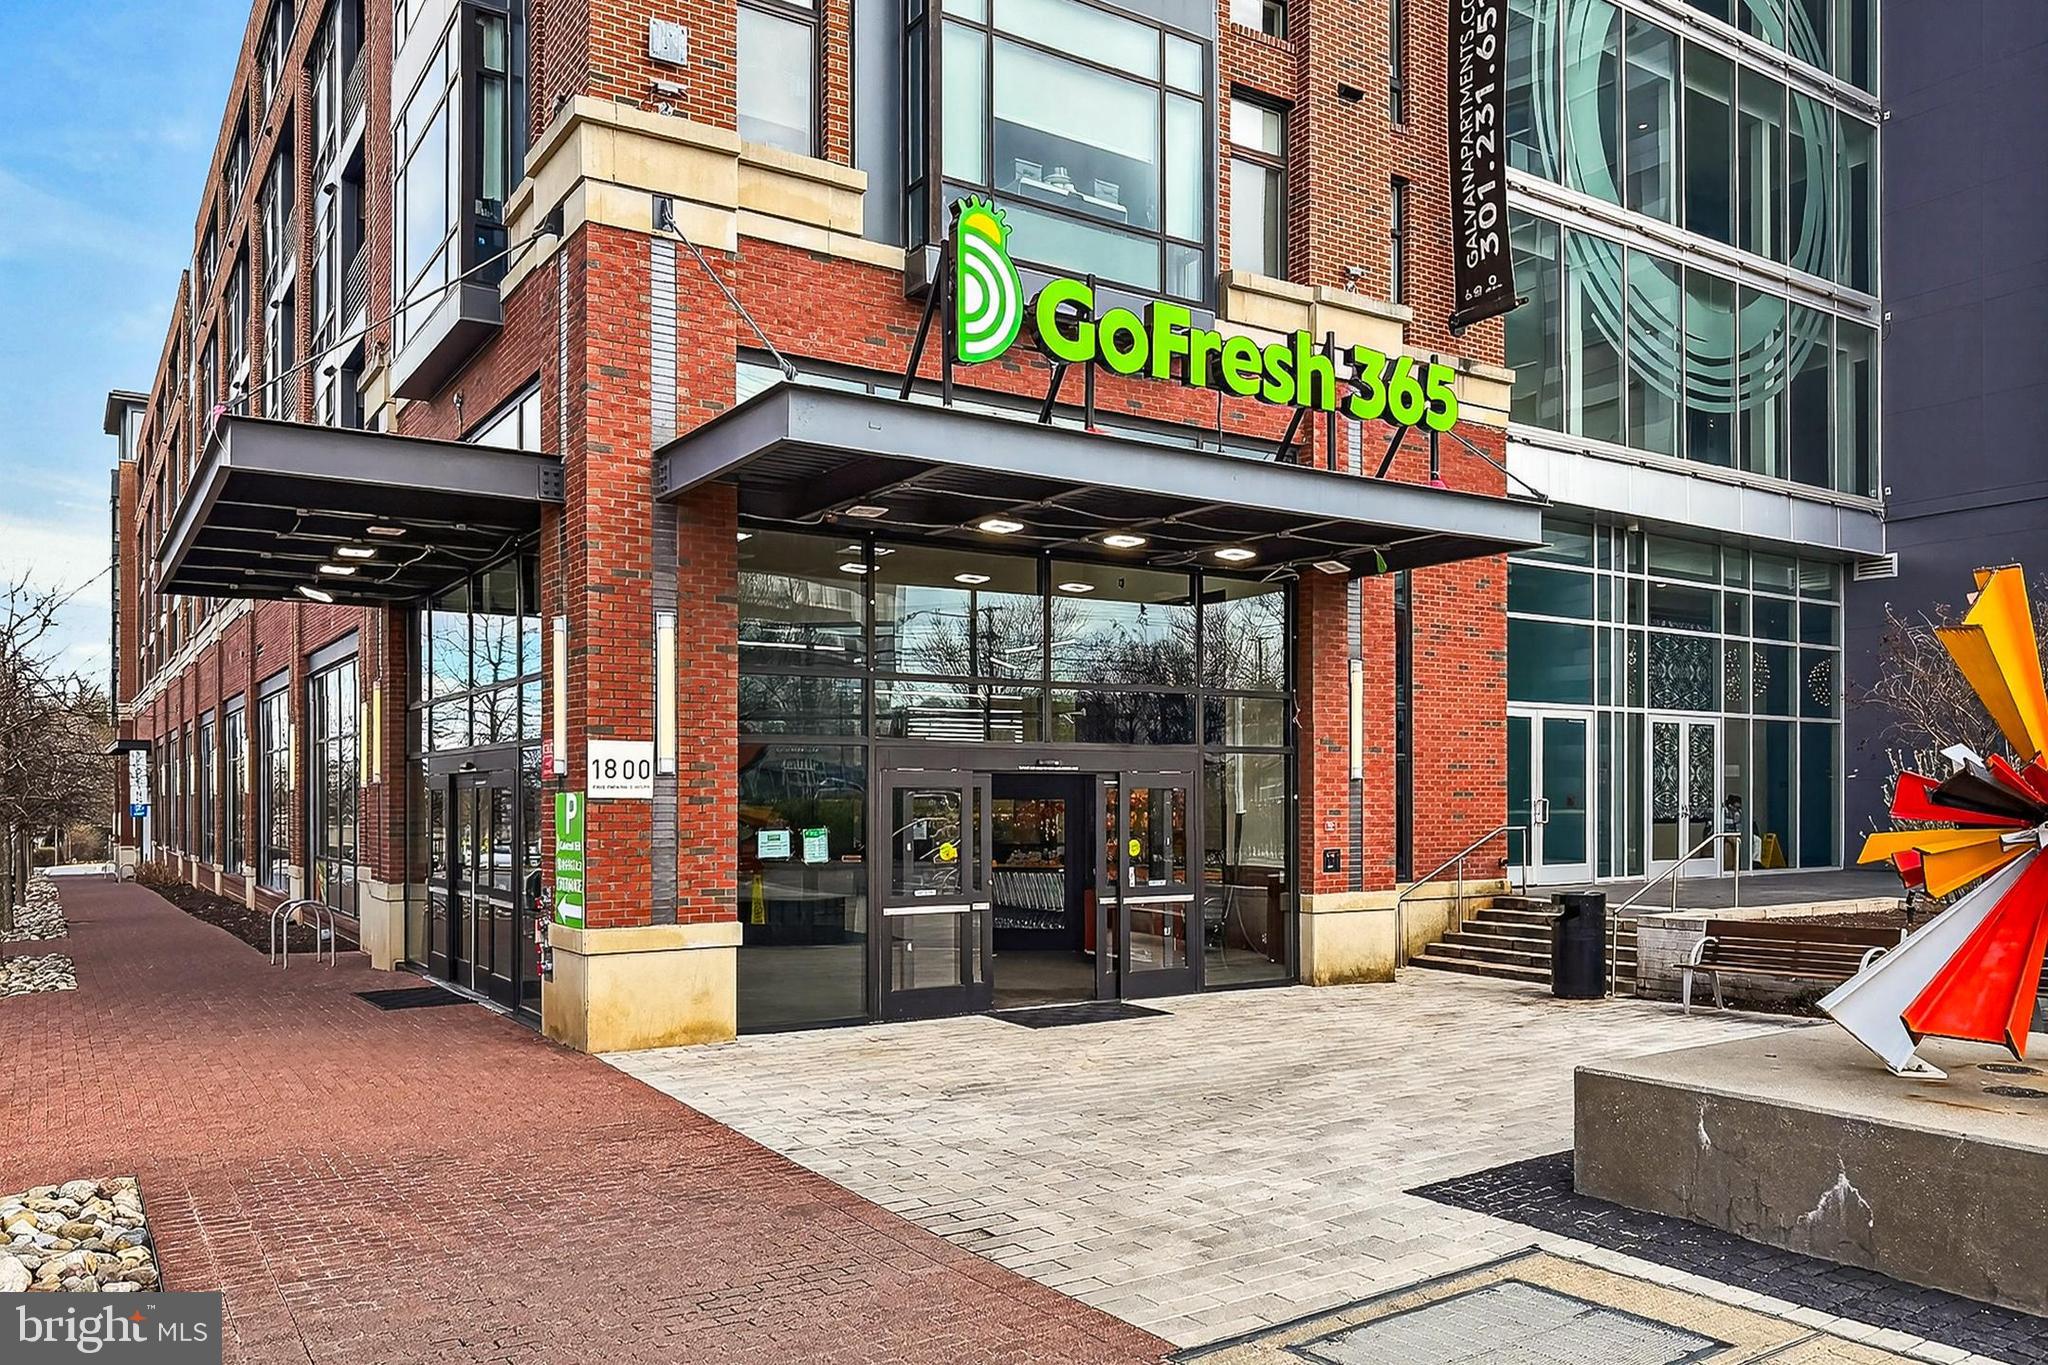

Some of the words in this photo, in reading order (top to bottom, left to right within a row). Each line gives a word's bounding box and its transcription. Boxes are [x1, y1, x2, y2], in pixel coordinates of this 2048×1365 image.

[1475, 0, 1500, 260] 301.231.65
[1036, 278, 1335, 412] GoFresh
[1350, 344, 1459, 433] 365
[565, 792, 577, 835] P
[592, 758, 650, 780] 1800
